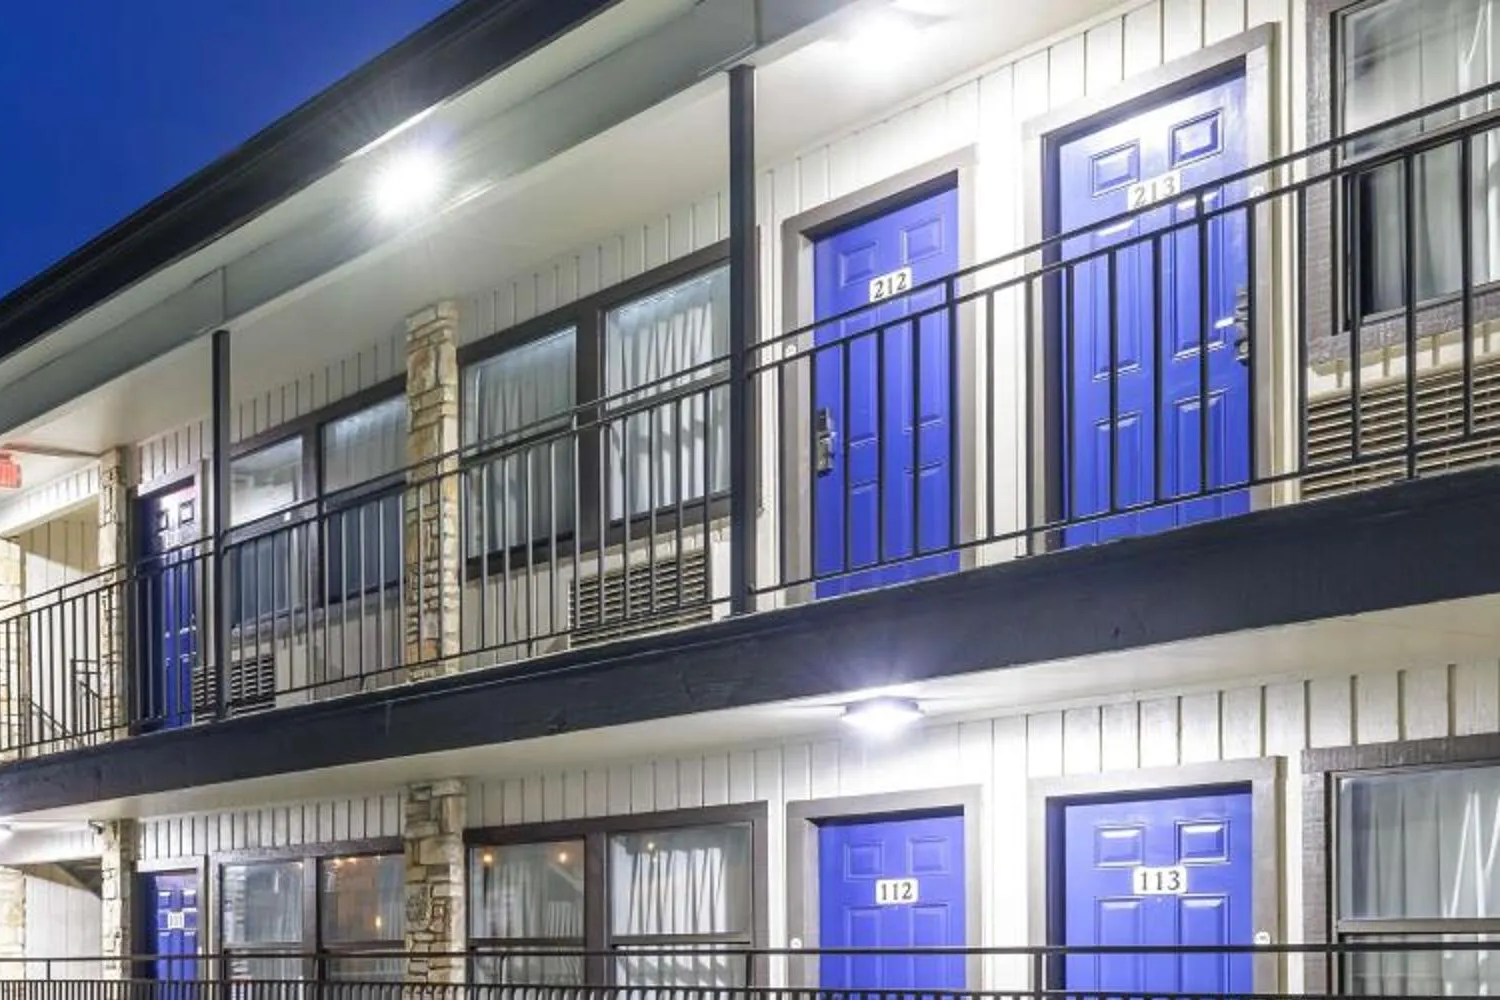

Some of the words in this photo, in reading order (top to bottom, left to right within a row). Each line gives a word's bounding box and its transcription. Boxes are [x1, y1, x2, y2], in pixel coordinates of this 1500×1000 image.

[1132, 176, 1174, 207] 213
[875, 272, 906, 298] 212
[881, 882, 913, 900] 112
[1140, 870, 1180, 891] 113
